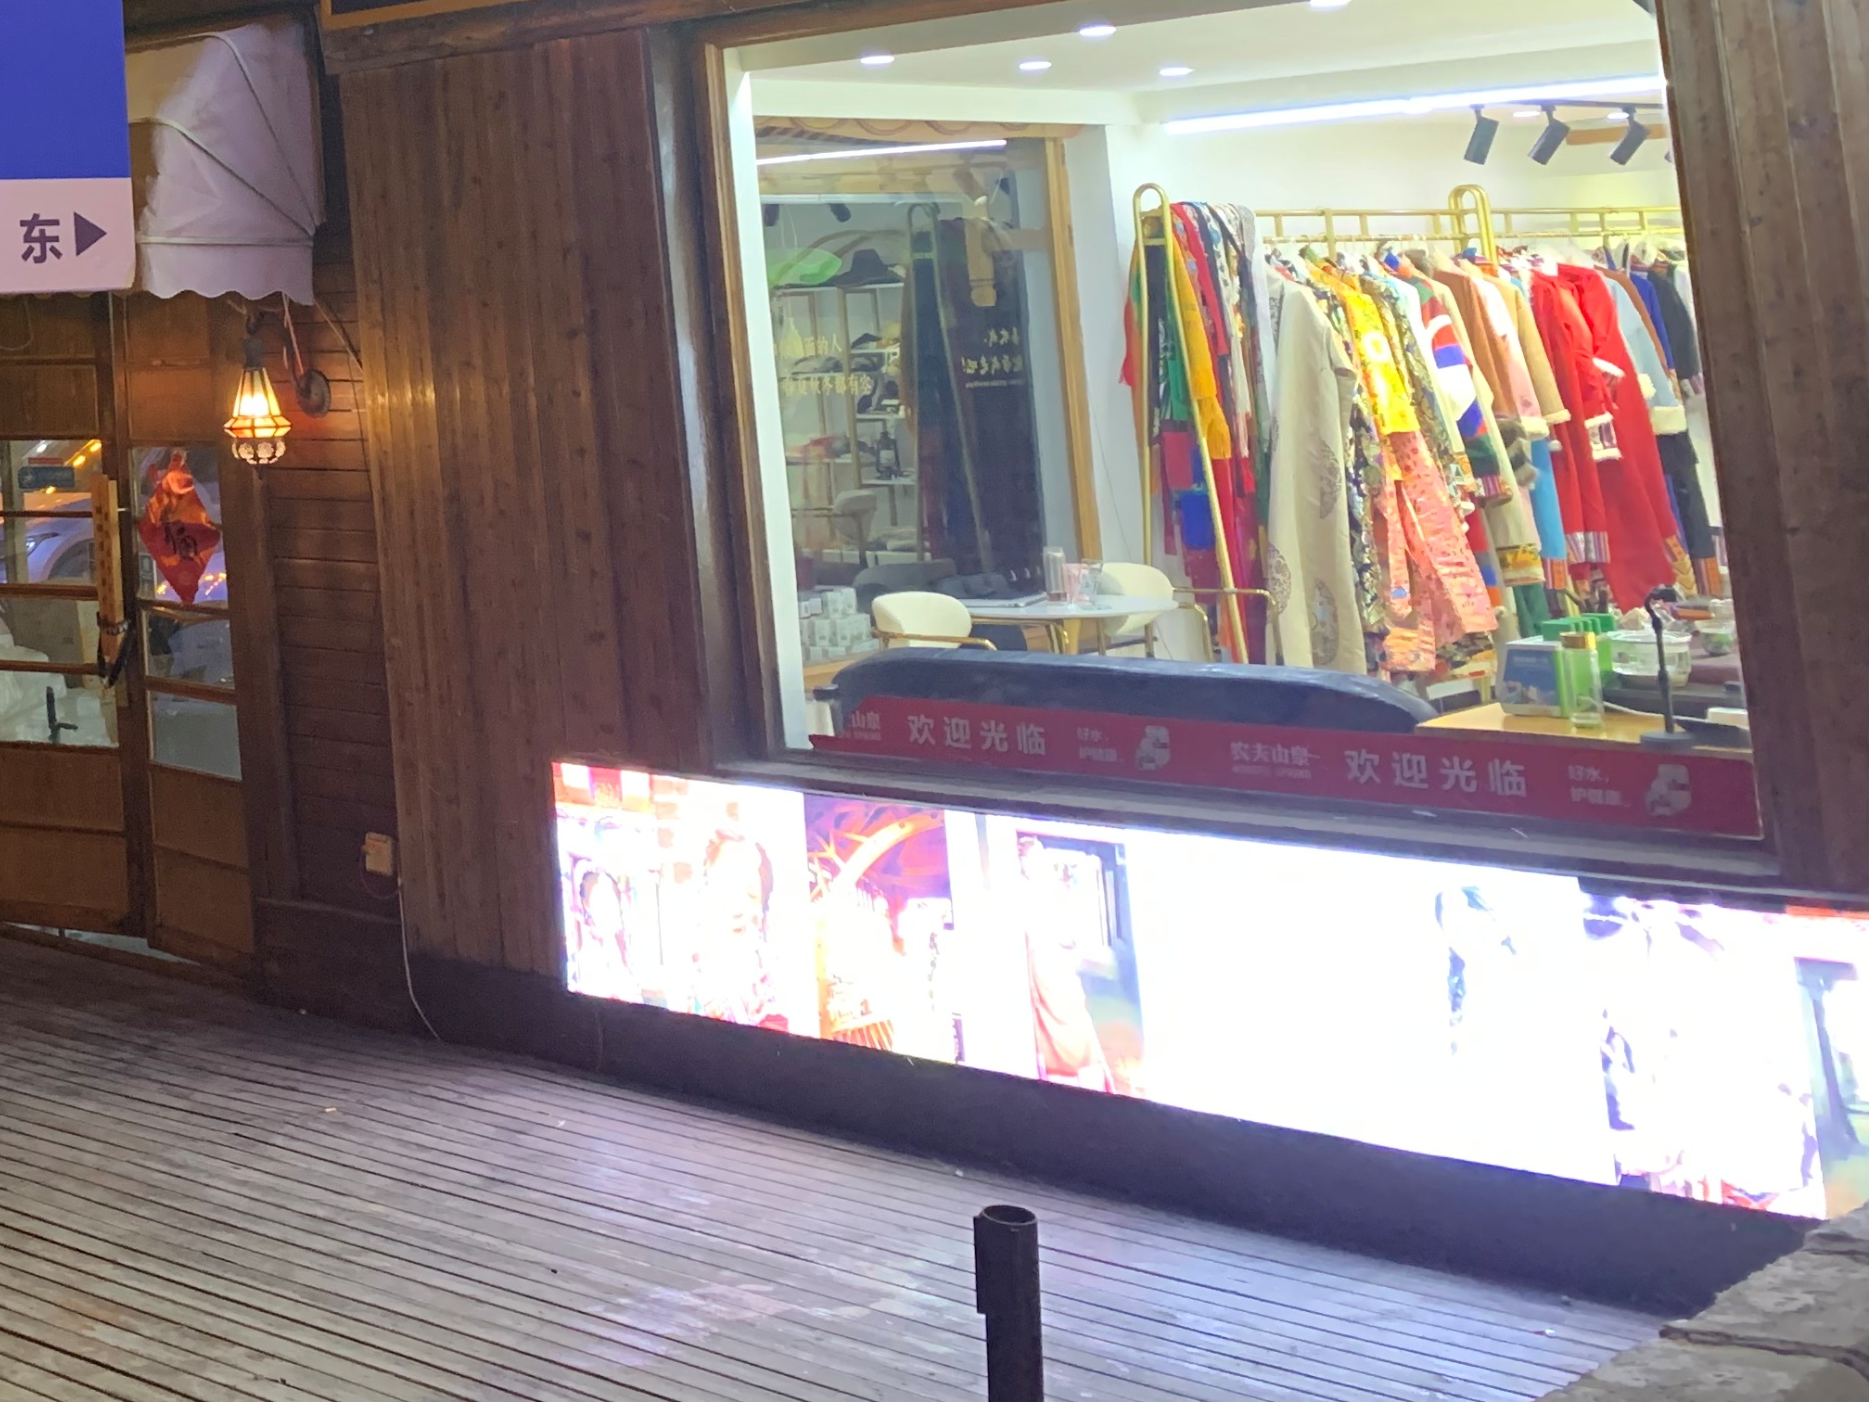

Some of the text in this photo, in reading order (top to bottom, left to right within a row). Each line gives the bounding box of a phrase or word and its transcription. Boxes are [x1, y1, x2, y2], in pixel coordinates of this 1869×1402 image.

[18, 212, 65, 265] 东
[906, 712, 1047, 757] 欢迎光临
[1229, 741, 1312, 768] 农夫山泉
[1343, 747, 1529, 798] 欢迎光临
